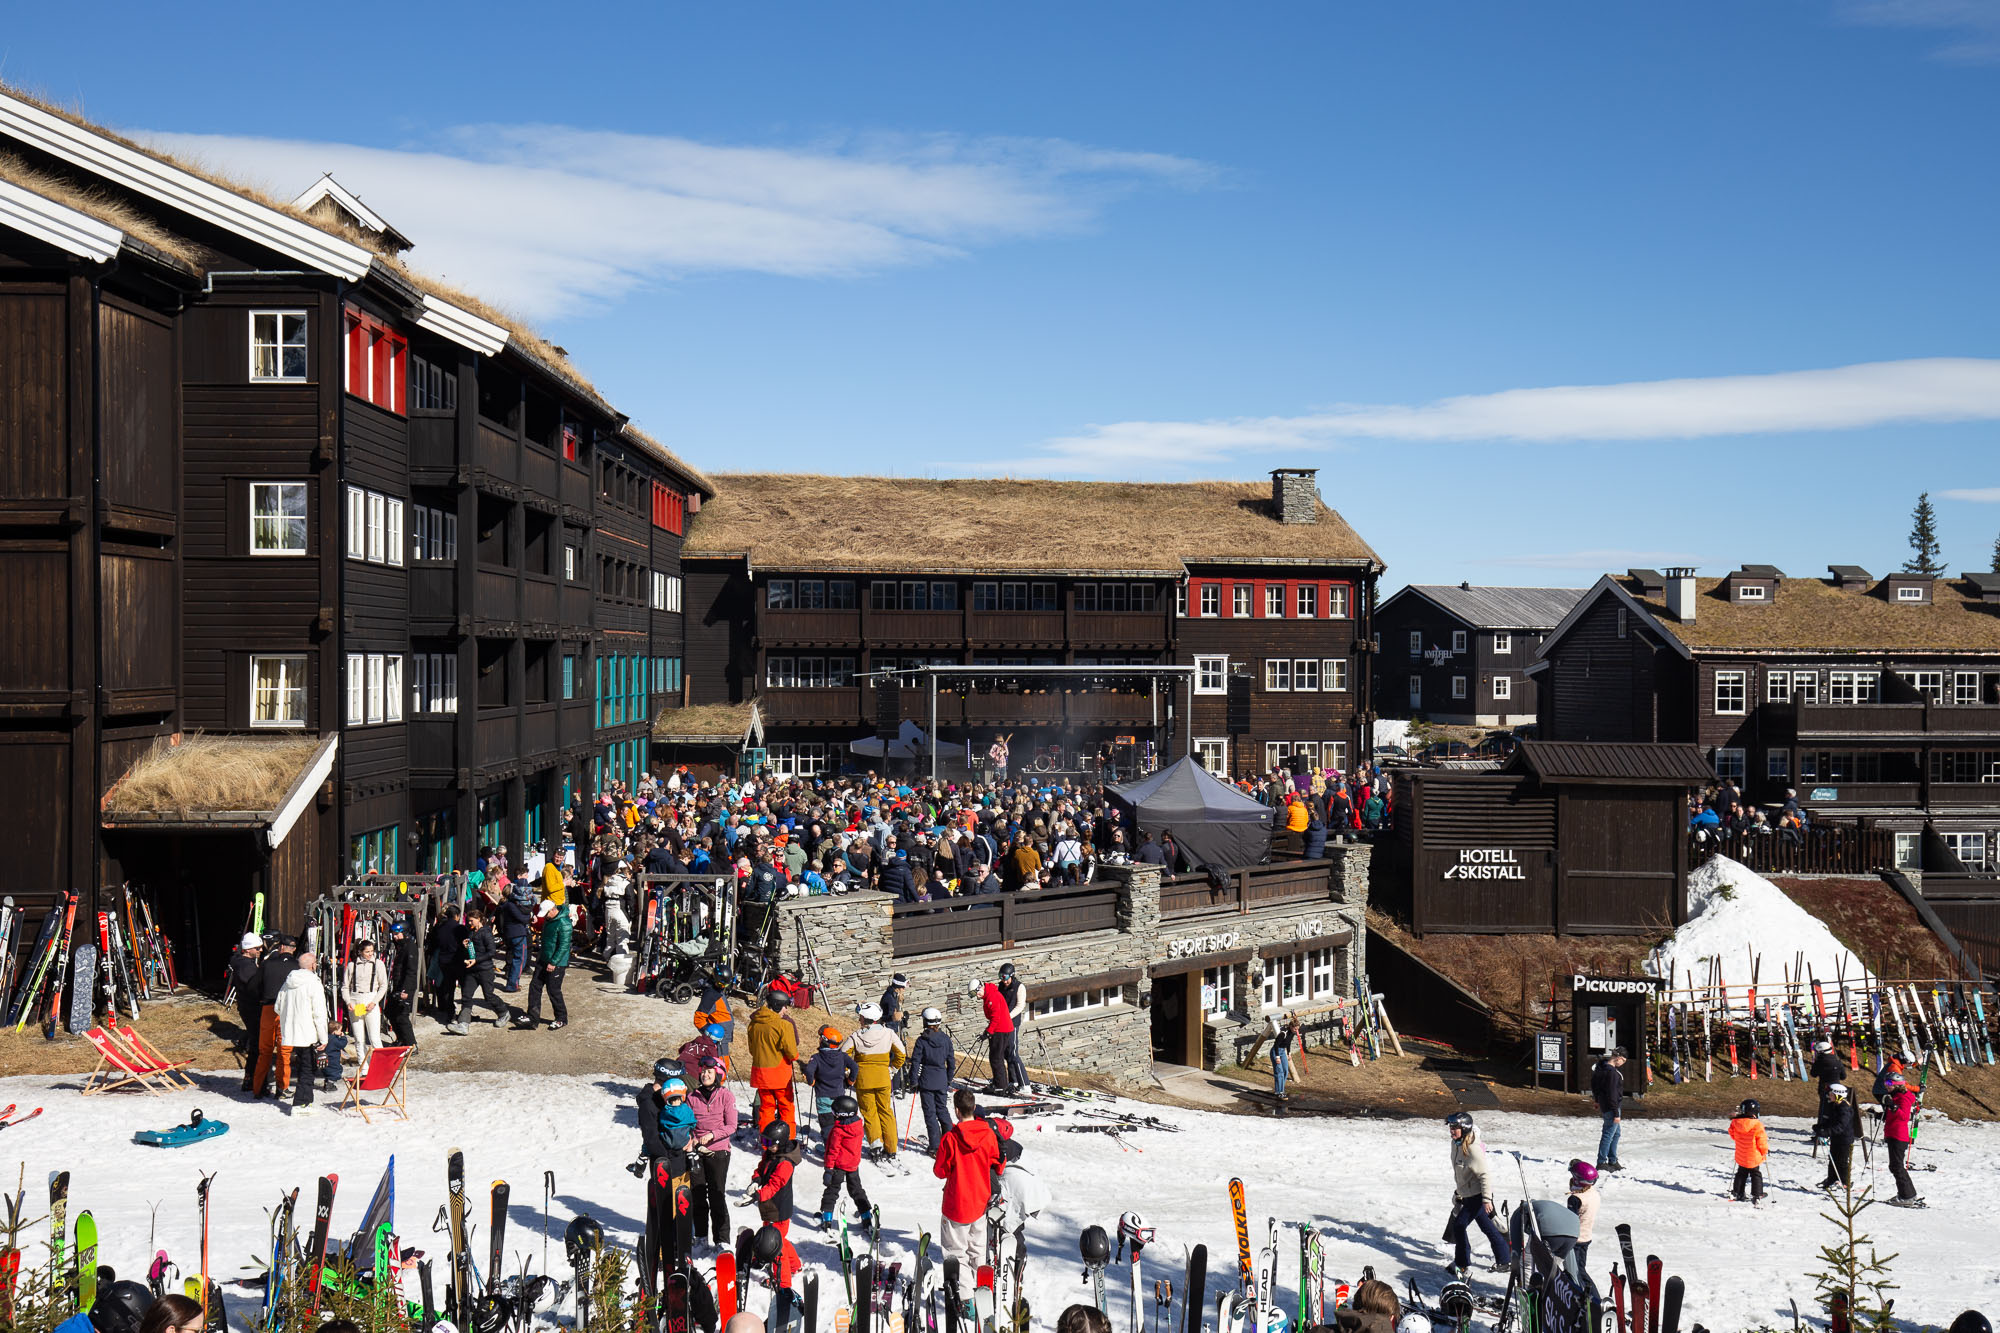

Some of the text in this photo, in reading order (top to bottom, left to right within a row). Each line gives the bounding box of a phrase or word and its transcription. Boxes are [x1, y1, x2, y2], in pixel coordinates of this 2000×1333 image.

[1460, 849, 1518, 863] HOTELL
[1458, 865, 1526, 880] SKISTALL
[1297, 920, 1323, 938] INFO
[1001, 1263, 1009, 1302] HEAD
[1260, 1268, 1269, 1313] HEAD
